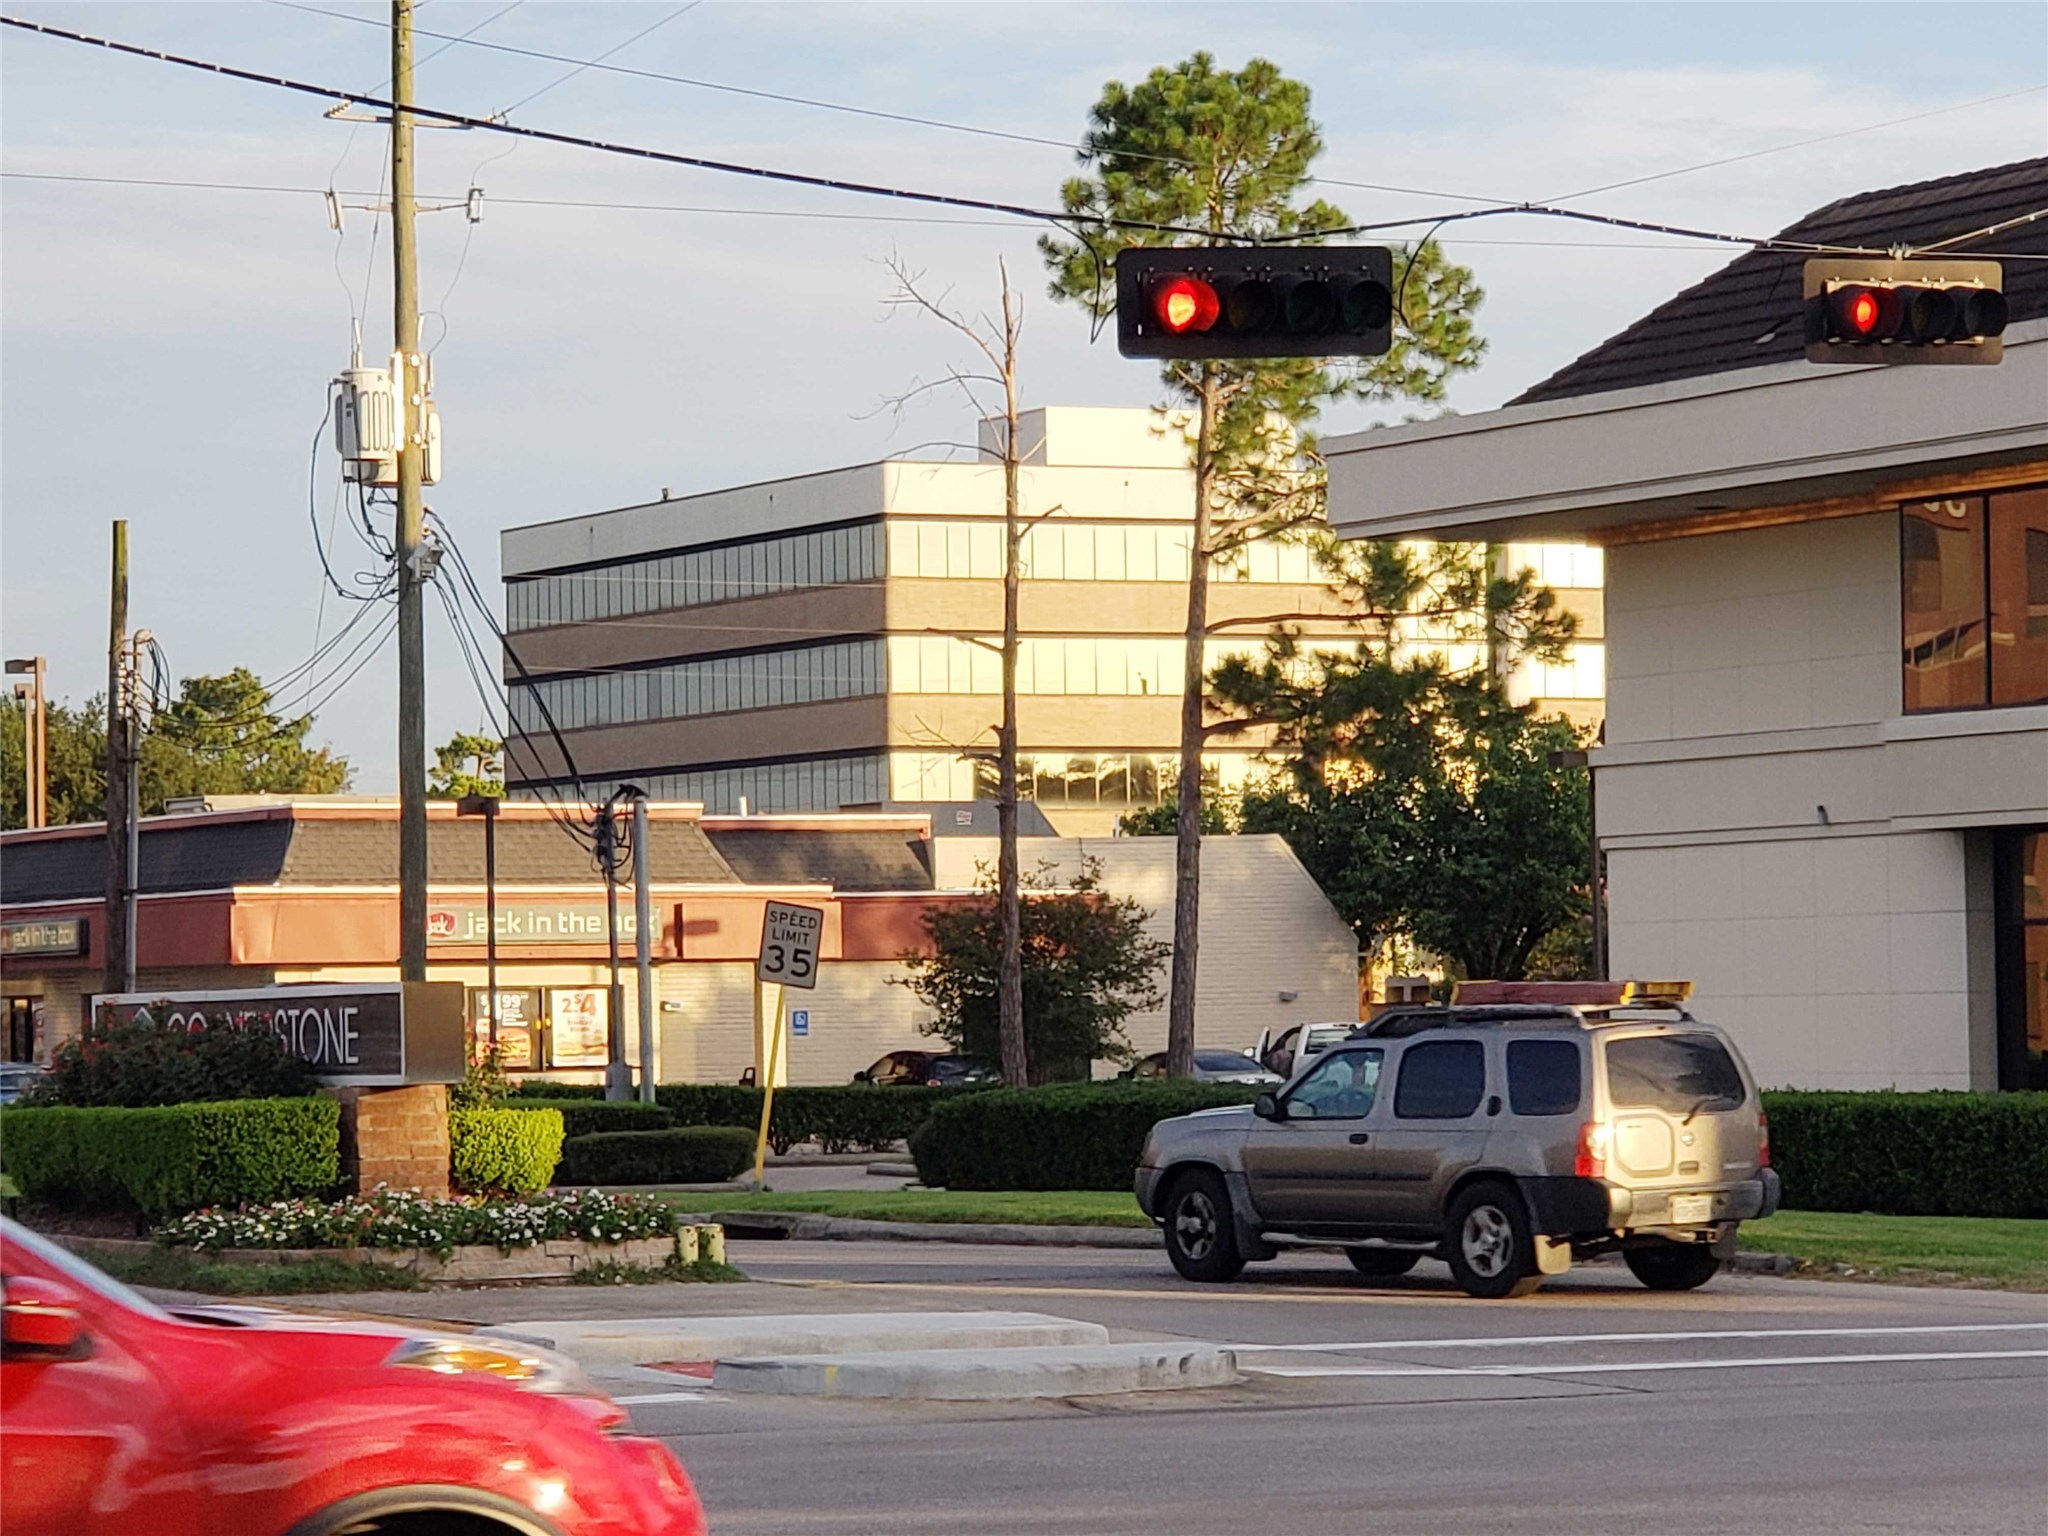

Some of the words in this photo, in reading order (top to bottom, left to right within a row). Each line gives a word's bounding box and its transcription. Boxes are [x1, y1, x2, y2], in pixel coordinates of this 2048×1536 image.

[463, 911, 521, 939] jack
[528, 911, 551, 933] in
[558, 911, 601, 933] the
[768, 910, 818, 929] SPEED
[772, 927, 810, 945] LIMIT
[765, 944, 812, 978] 35
